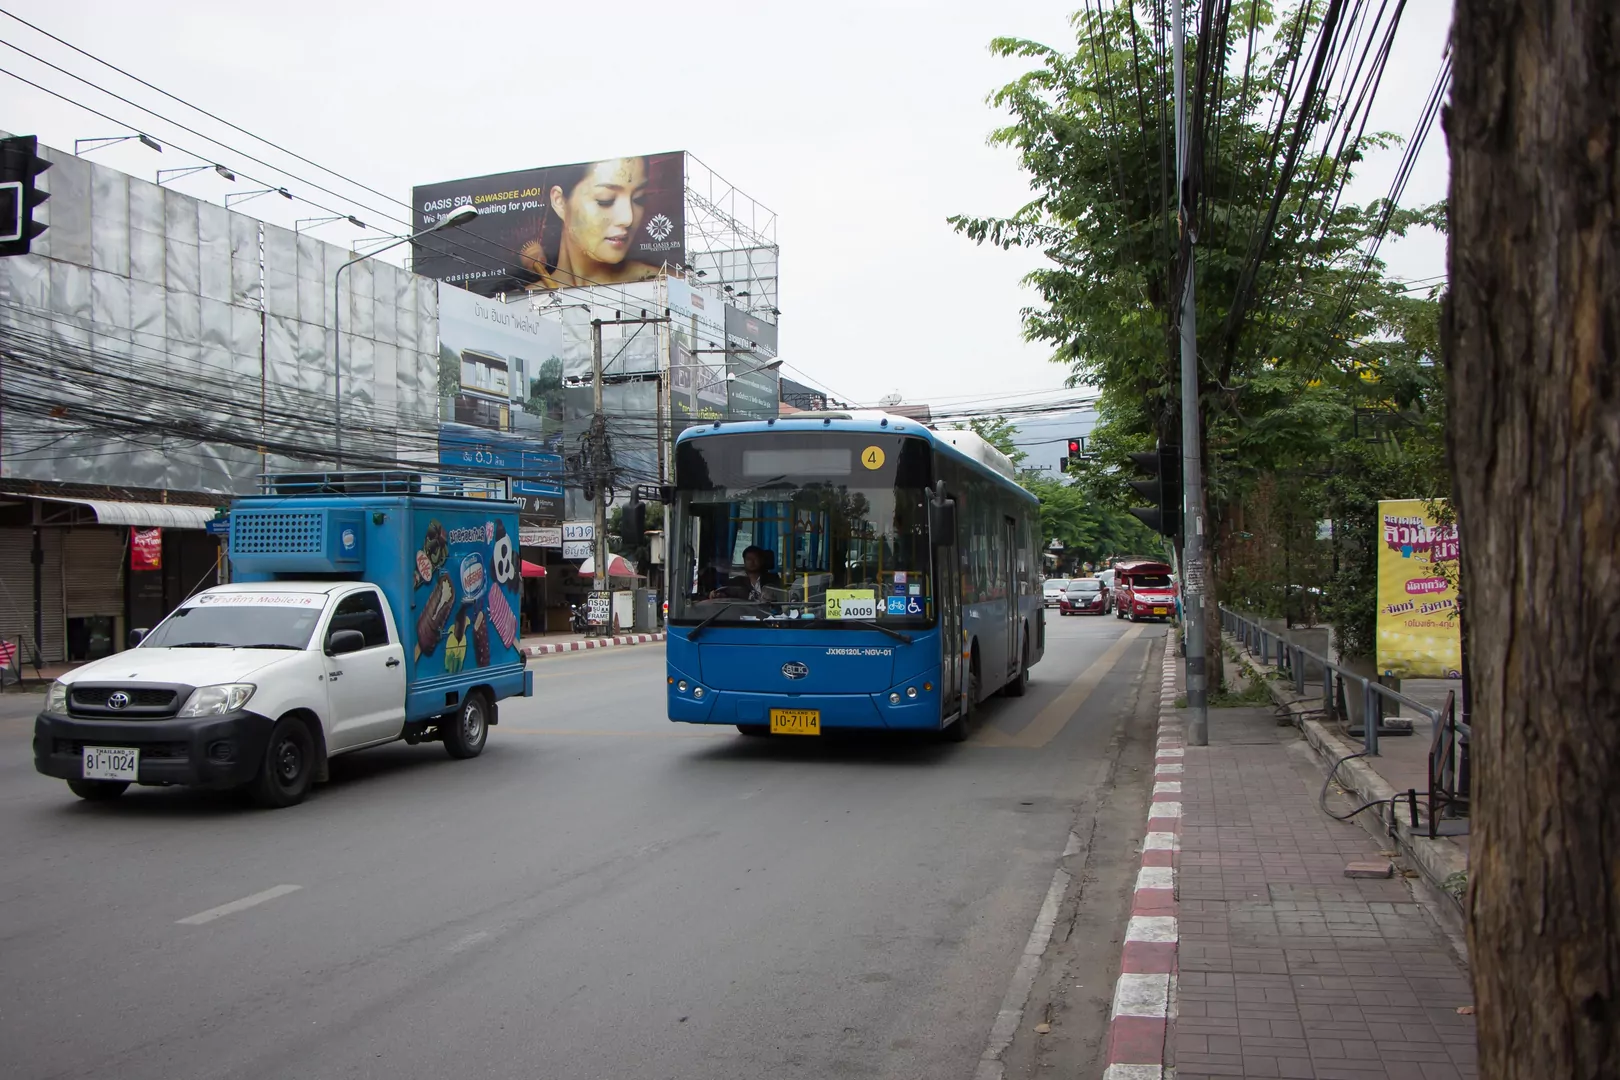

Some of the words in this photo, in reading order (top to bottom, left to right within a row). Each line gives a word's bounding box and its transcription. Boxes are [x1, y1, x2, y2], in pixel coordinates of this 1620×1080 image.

[424, 198, 452, 212] OASIS
[454, 195, 473, 207] SPA
[475, 190, 519, 204] SAWASDEE
[520, 188, 541, 198] JAO!
[423, 215, 436, 224] We
[478, 204, 507, 216] waiting
[508, 201, 520, 211] for
[652, 241, 670, 249] OASIS
[867, 450, 877, 464] 4
[565, 525, 594, 540] นวด
[587, 599, 610, 607] กรอบ
[876, 599, 887, 612] 4
[1387, 599, 1414, 614] จันทร์
[1420, 599, 1453, 614] อังคาร
[844, 607, 873, 616] A009
[825, 648, 892, 656] JXK6120L-NGV-01
[775, 715, 817, 728] 10-7114
[87, 754, 135, 771] 81-1024
